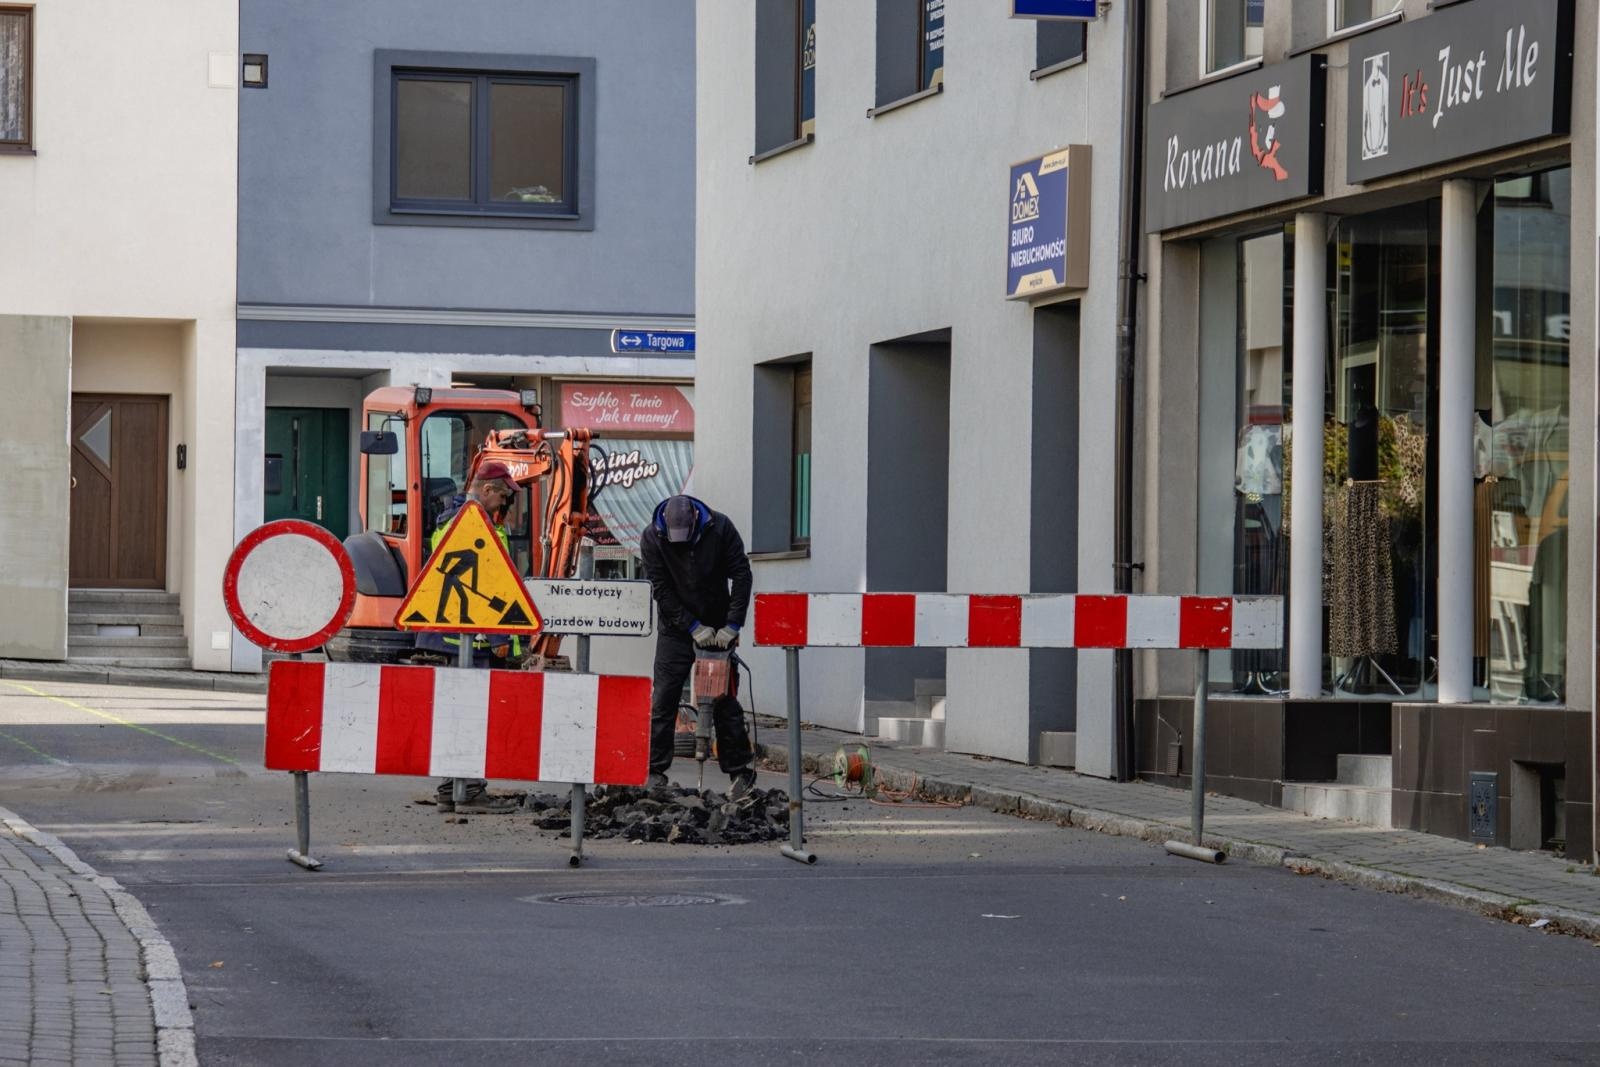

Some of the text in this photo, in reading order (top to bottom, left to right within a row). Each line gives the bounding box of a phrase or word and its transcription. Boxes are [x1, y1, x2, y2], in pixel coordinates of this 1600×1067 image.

[1400, 24, 1539, 129] It's Just Me
[1164, 133, 1242, 192] Roxana
[1012, 196, 1040, 220] DOMEX
[1012, 226, 1034, 247] BIURO
[1011, 237, 1066, 268] NIERUCHOMOŚCI
[647, 333, 685, 350] Targowa
[571, 391, 663, 411] Szybko Tanio
[596, 407, 679, 428] Jak u mamy!
[551, 585, 622, 599] Nie dotyczy
[543, 615, 645, 632] ojazdów budowy
